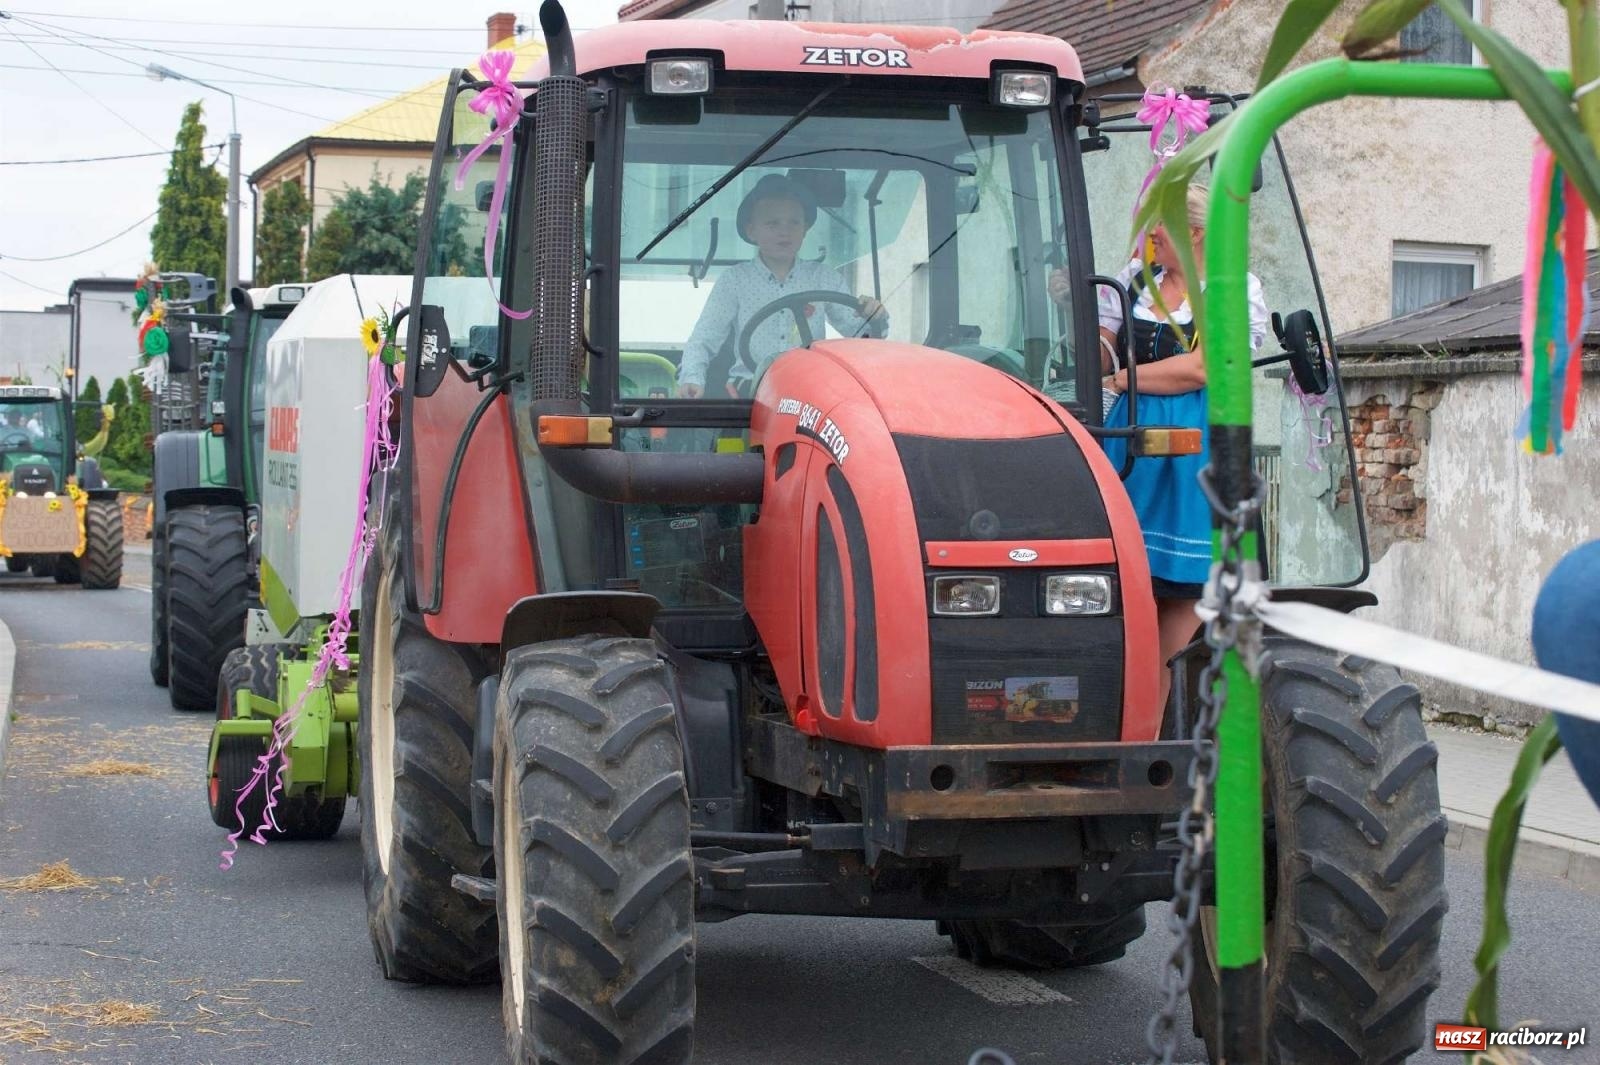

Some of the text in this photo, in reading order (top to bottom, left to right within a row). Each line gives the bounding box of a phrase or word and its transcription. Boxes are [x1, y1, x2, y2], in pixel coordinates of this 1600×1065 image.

[801, 46, 912, 68] ZETOR
[269, 406, 299, 453] CLAAS
[799, 403, 821, 431] 8641
[819, 416, 849, 465] ZETOR
[1011, 550, 1036, 559] Zetor
